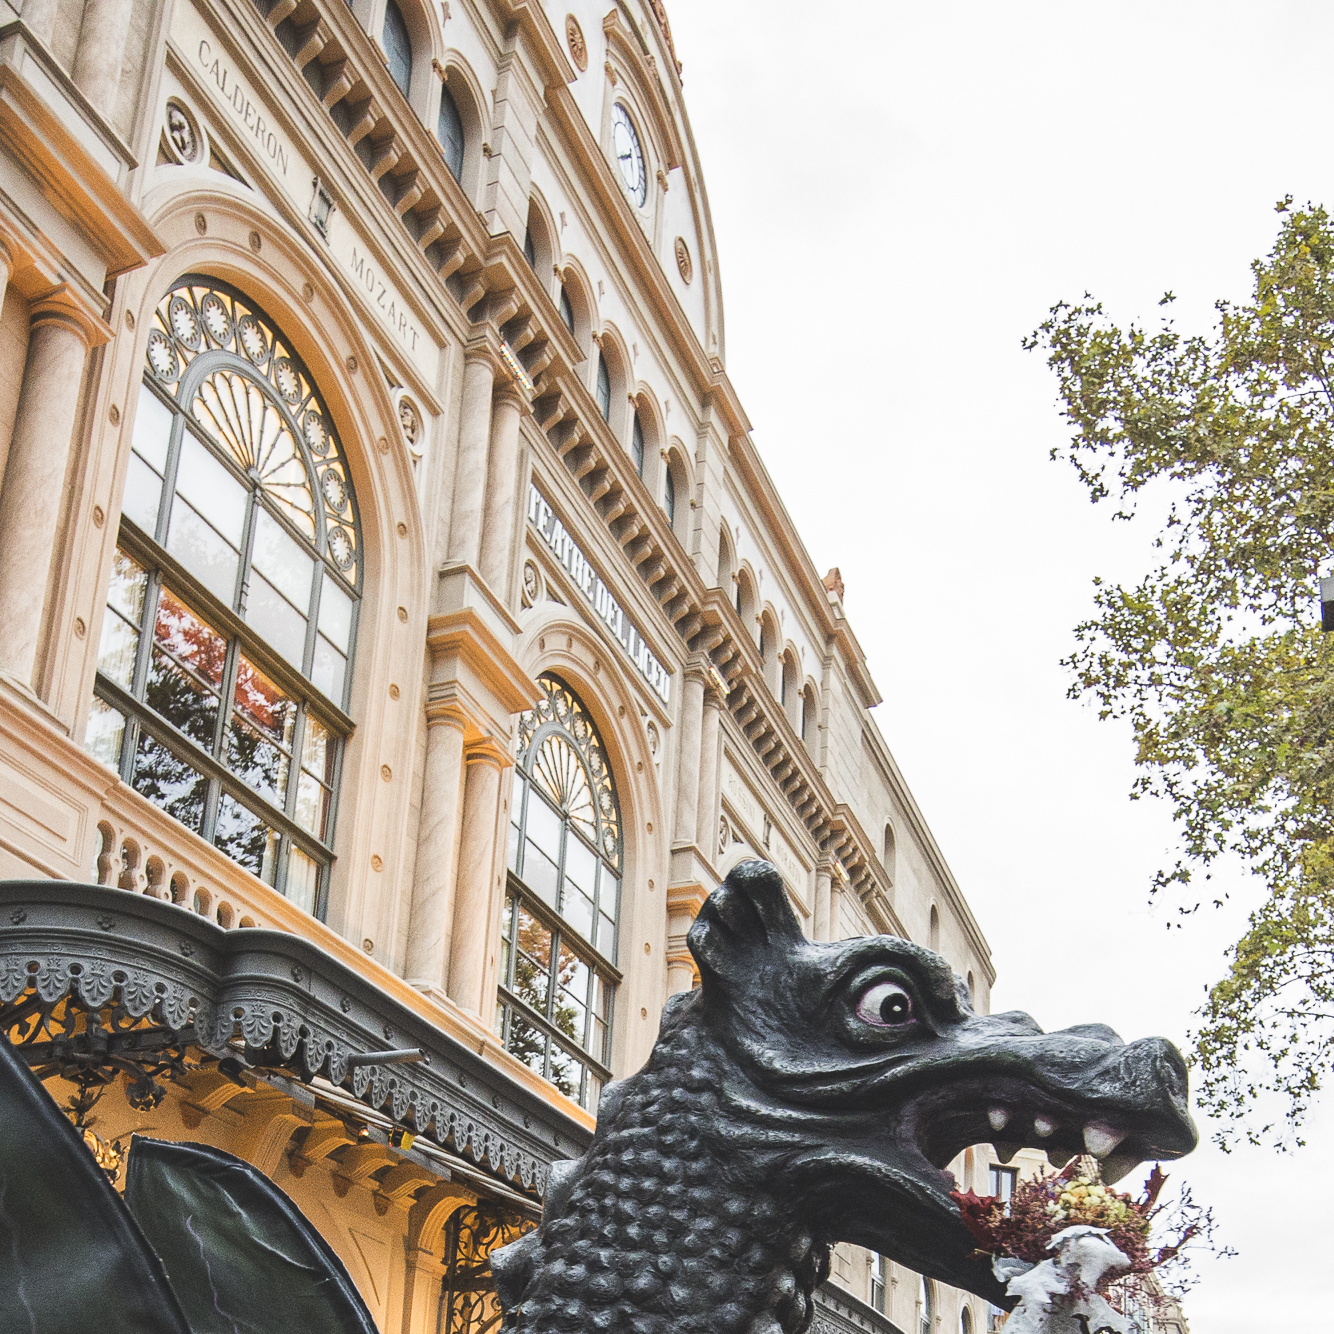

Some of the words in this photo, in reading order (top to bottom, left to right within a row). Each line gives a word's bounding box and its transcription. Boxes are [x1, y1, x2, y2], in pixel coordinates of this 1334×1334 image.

[198, 40, 289, 176] CALDERON
[351, 247, 420, 352] MOZART
[528, 482, 596, 602] TEATRE
[594, 579, 628, 649] DEL
[628, 624, 672, 704] LICEU
